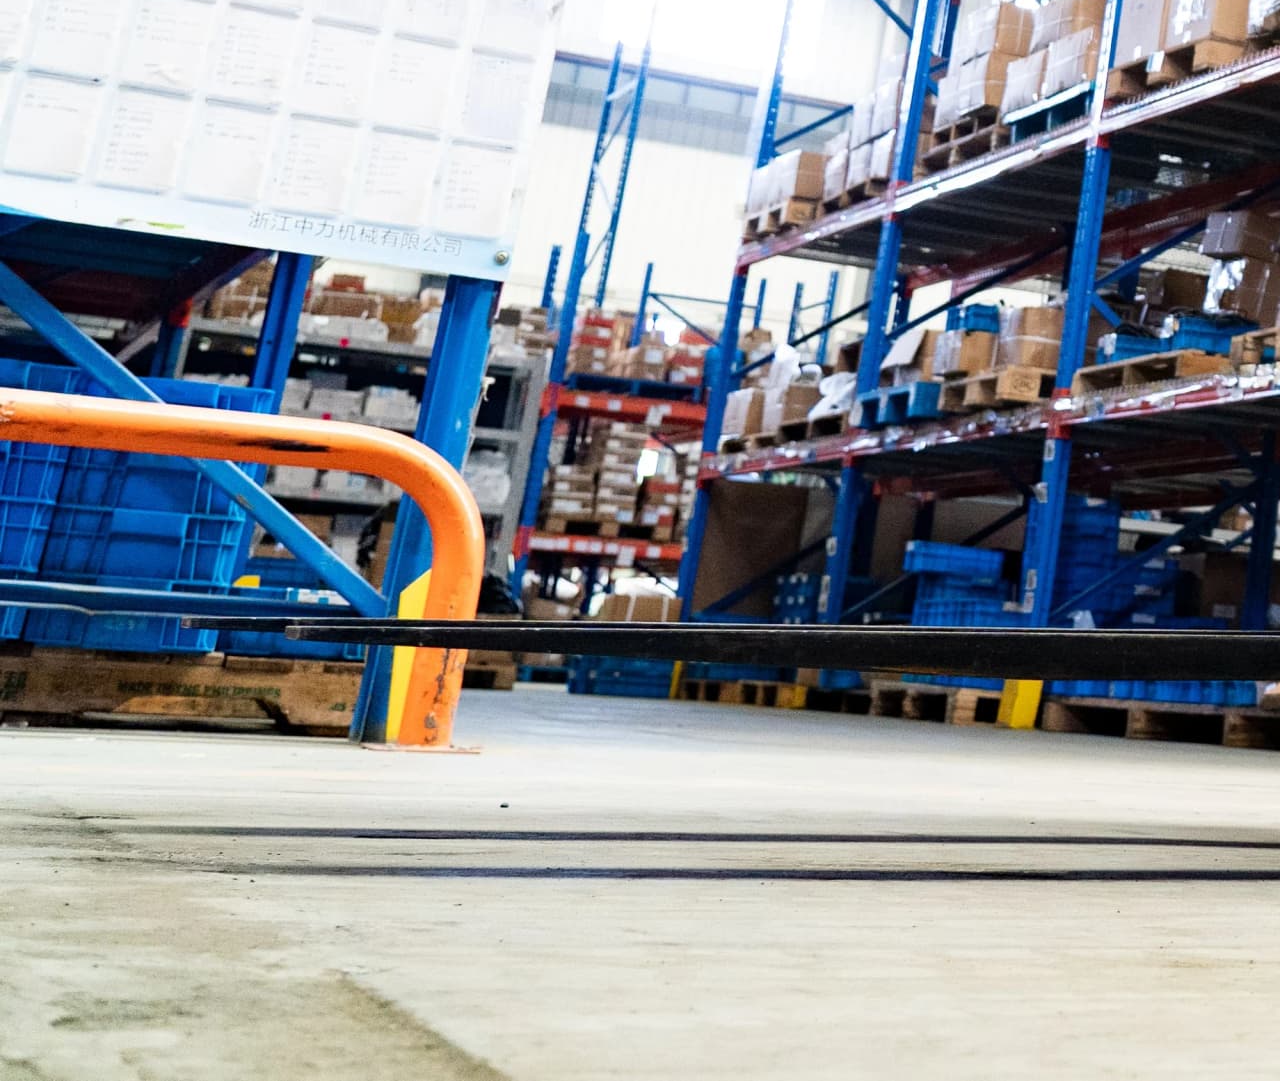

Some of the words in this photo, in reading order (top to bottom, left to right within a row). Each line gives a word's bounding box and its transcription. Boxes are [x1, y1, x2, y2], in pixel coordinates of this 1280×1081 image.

[248, 209, 463, 257] 浙江中力机械有限公司
